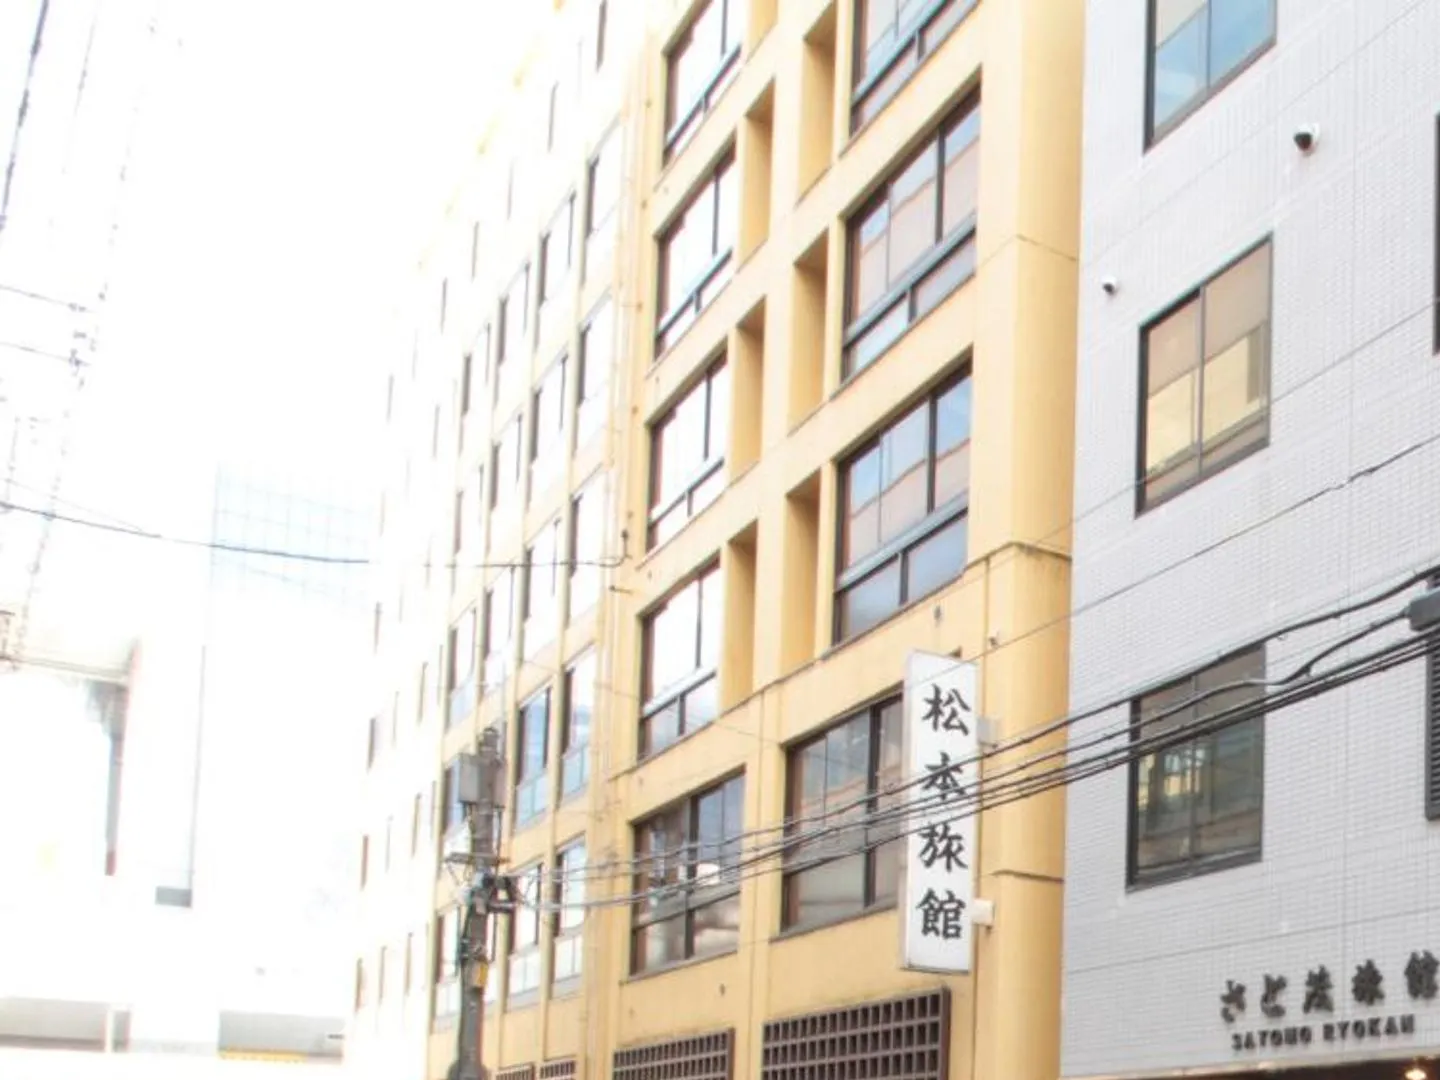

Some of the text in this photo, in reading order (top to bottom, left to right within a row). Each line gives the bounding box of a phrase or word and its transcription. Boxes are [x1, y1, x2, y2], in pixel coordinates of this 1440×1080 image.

[916, 683, 971, 940] 松本旅館
[1231, 1013, 1415, 1051] SATOMO RYOKAN
